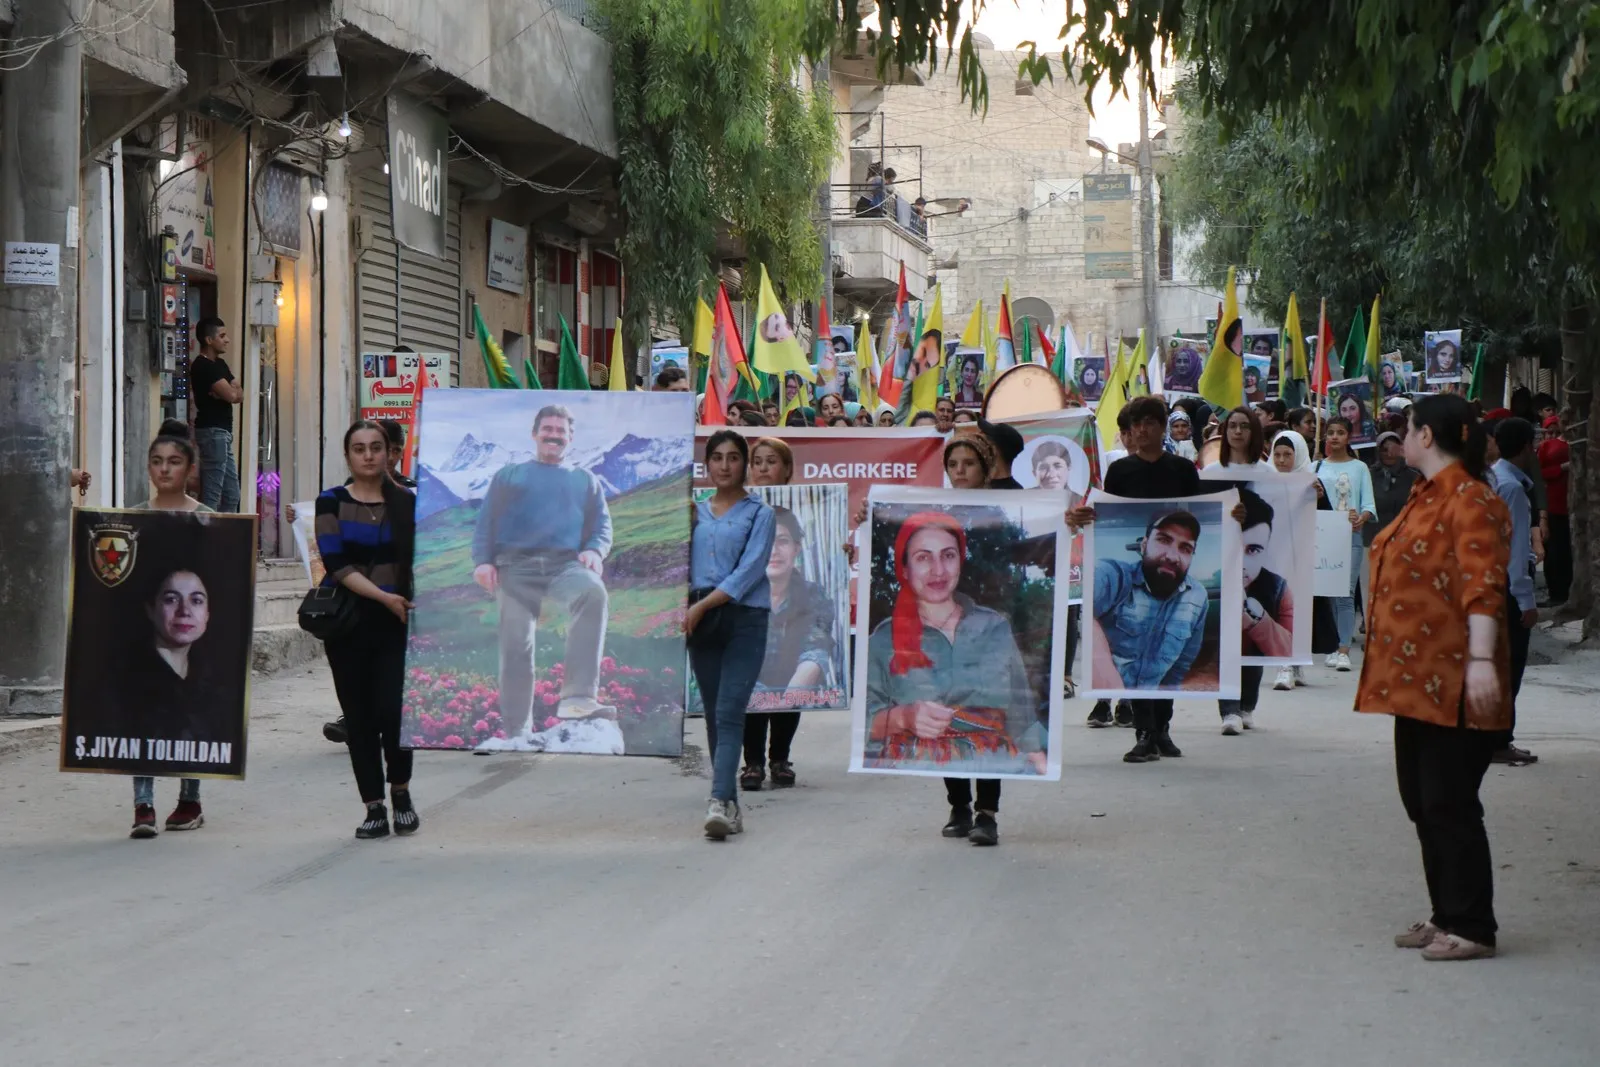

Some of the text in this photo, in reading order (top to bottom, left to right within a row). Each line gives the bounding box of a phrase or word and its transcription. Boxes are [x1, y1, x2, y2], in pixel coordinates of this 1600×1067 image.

[396, 129, 441, 217] Cîhad
[804, 463, 917, 479] DAGIRKERE
[75, 735, 232, 764] Ş.JIYAN TOLHILDAN
